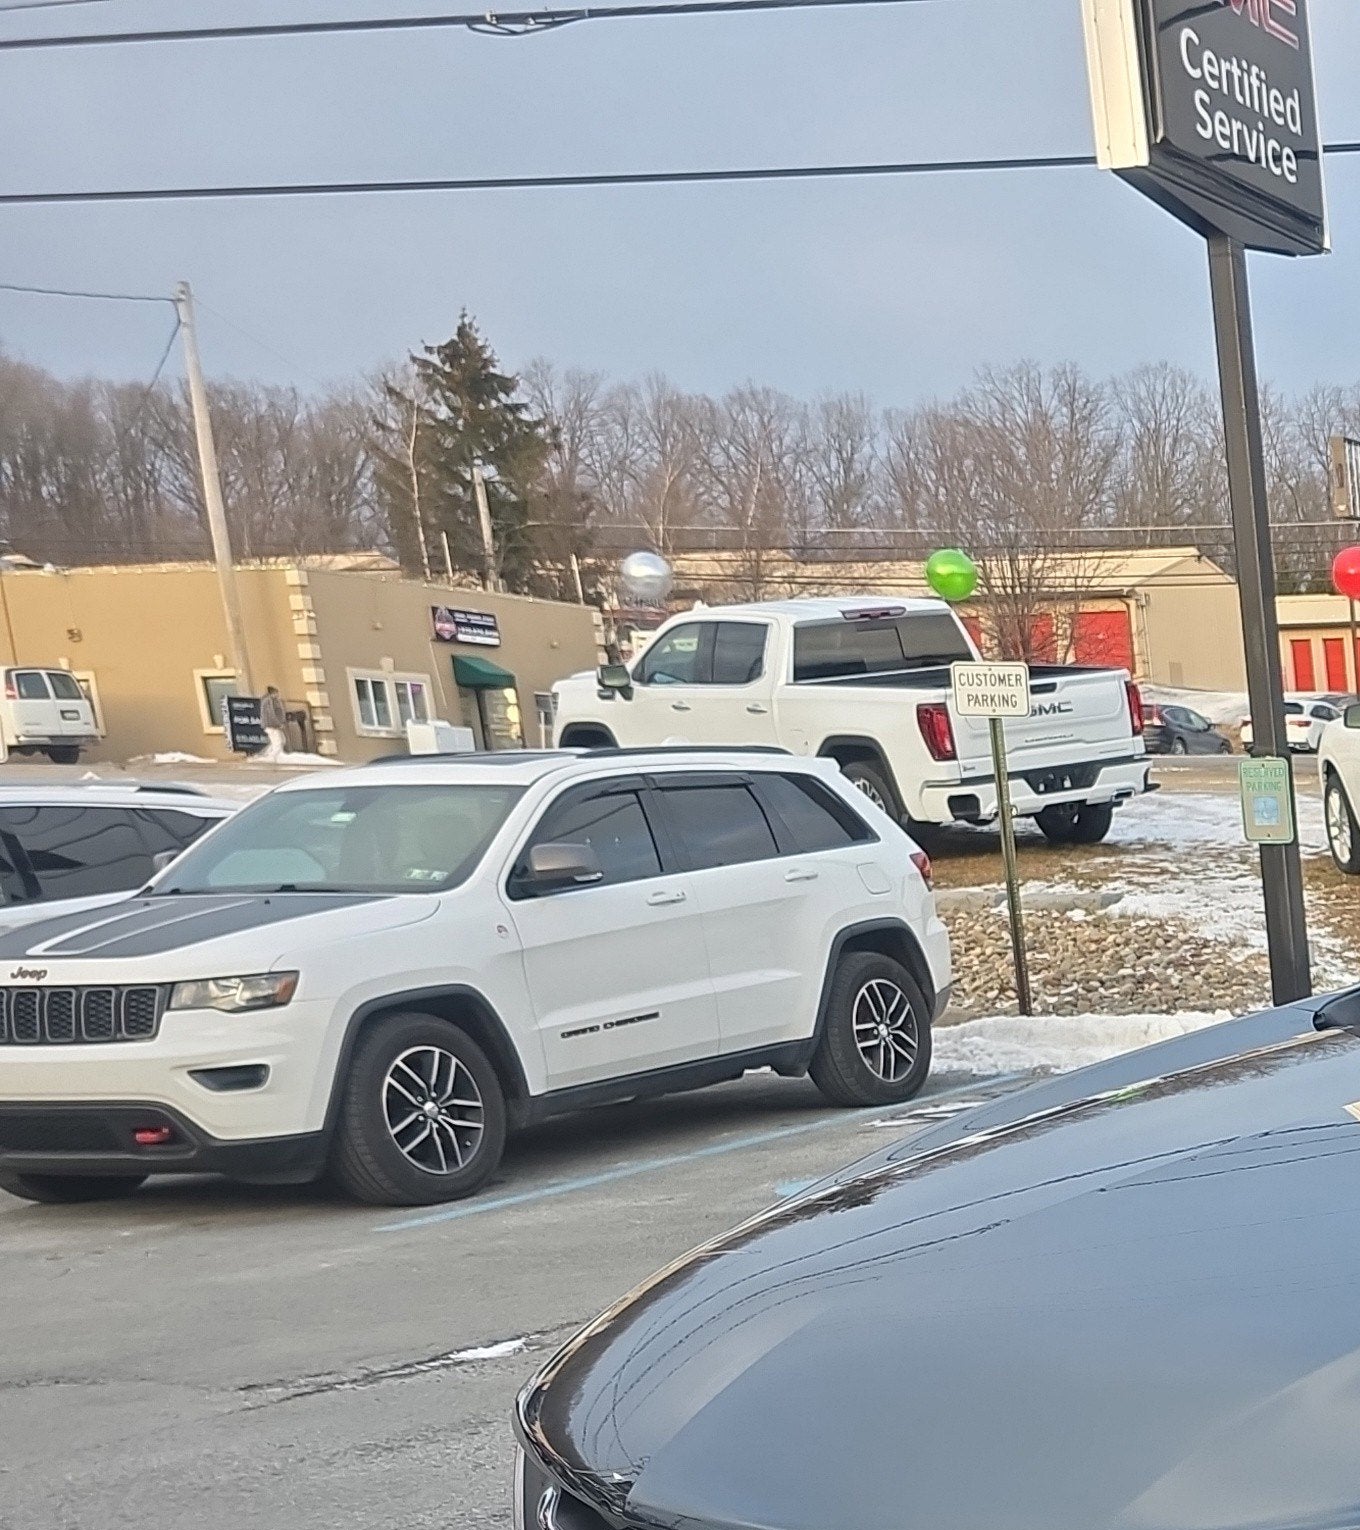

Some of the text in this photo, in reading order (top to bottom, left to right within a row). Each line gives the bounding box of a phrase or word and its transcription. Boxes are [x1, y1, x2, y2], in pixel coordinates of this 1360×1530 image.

[1180, 27, 1302, 136] Certified
[1194, 89, 1298, 183] Service
[958, 673, 1023, 687] CUSTOMER
[967, 694, 1018, 708] PARKING
[1242, 768, 1284, 777] RESERVED
[1246, 782, 1282, 791] PARKING
[10, 966, 48, 981] Jeep
